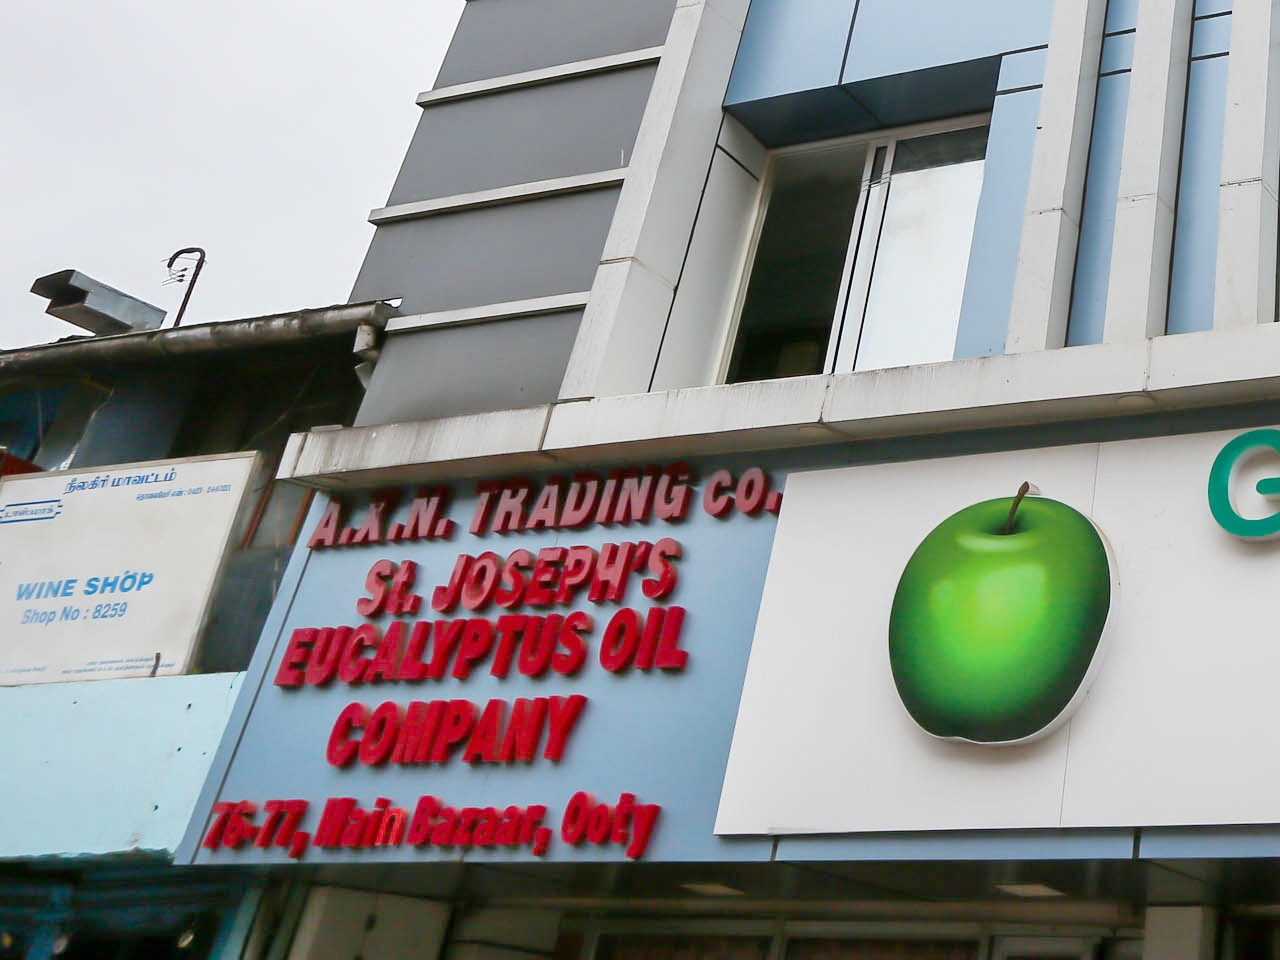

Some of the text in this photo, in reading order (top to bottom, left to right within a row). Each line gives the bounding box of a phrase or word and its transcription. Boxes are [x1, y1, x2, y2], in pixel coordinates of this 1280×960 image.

[111, 468, 177, 488] மாவட்டம்
[467, 461, 694, 537] TRADING
[703, 467, 783, 519] CO.
[16, 579, 78, 600] WINE
[431, 537, 683, 613] JOSEPH'S
[21, 606, 57, 626] Shop
[92, 601, 128, 620] 8259
[274, 606, 690, 687] EUCALYPTUS OIL
[326, 694, 589, 768] COMPANY
[313, 796, 403, 848] Main
[405, 795, 551, 857] Bazaar,
[560, 791, 661, 860] Ooty
